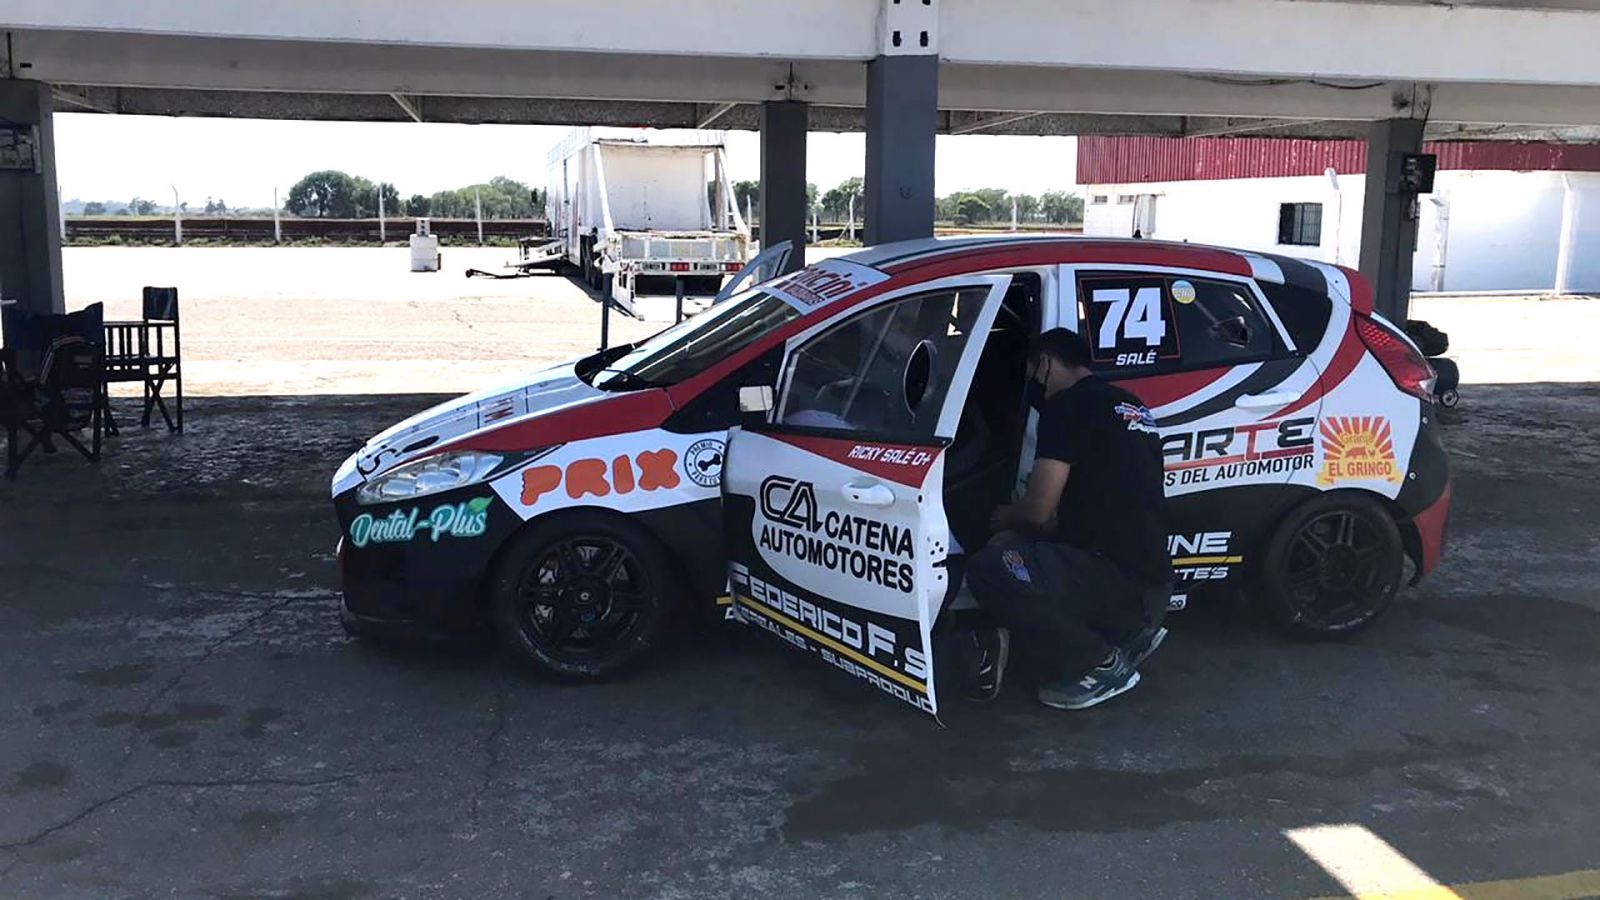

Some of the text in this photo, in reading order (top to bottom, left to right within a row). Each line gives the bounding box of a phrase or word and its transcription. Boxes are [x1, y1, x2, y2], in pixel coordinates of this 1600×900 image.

[1092, 287, 1166, 349] 74
[1115, 350, 1155, 366] SALÉ
[847, 445, 885, 461] RICKY
[880, 447, 916, 465] SALÉ
[1181, 468, 1209, 485] DEL
[1215, 455, 1314, 480] AUTOMOTOR
[1328, 461, 1392, 476] EL GRINGO
[520, 448, 680, 506] PRIX
[350, 502, 488, 547] Dental-Plus
[825, 511, 914, 560] CATENA
[1167, 531, 1232, 555] NE
[760, 525, 914, 593] AUTOMOTORES
[1174, 566, 1229, 580] TES
[725, 560, 863, 650] FEDERICO
